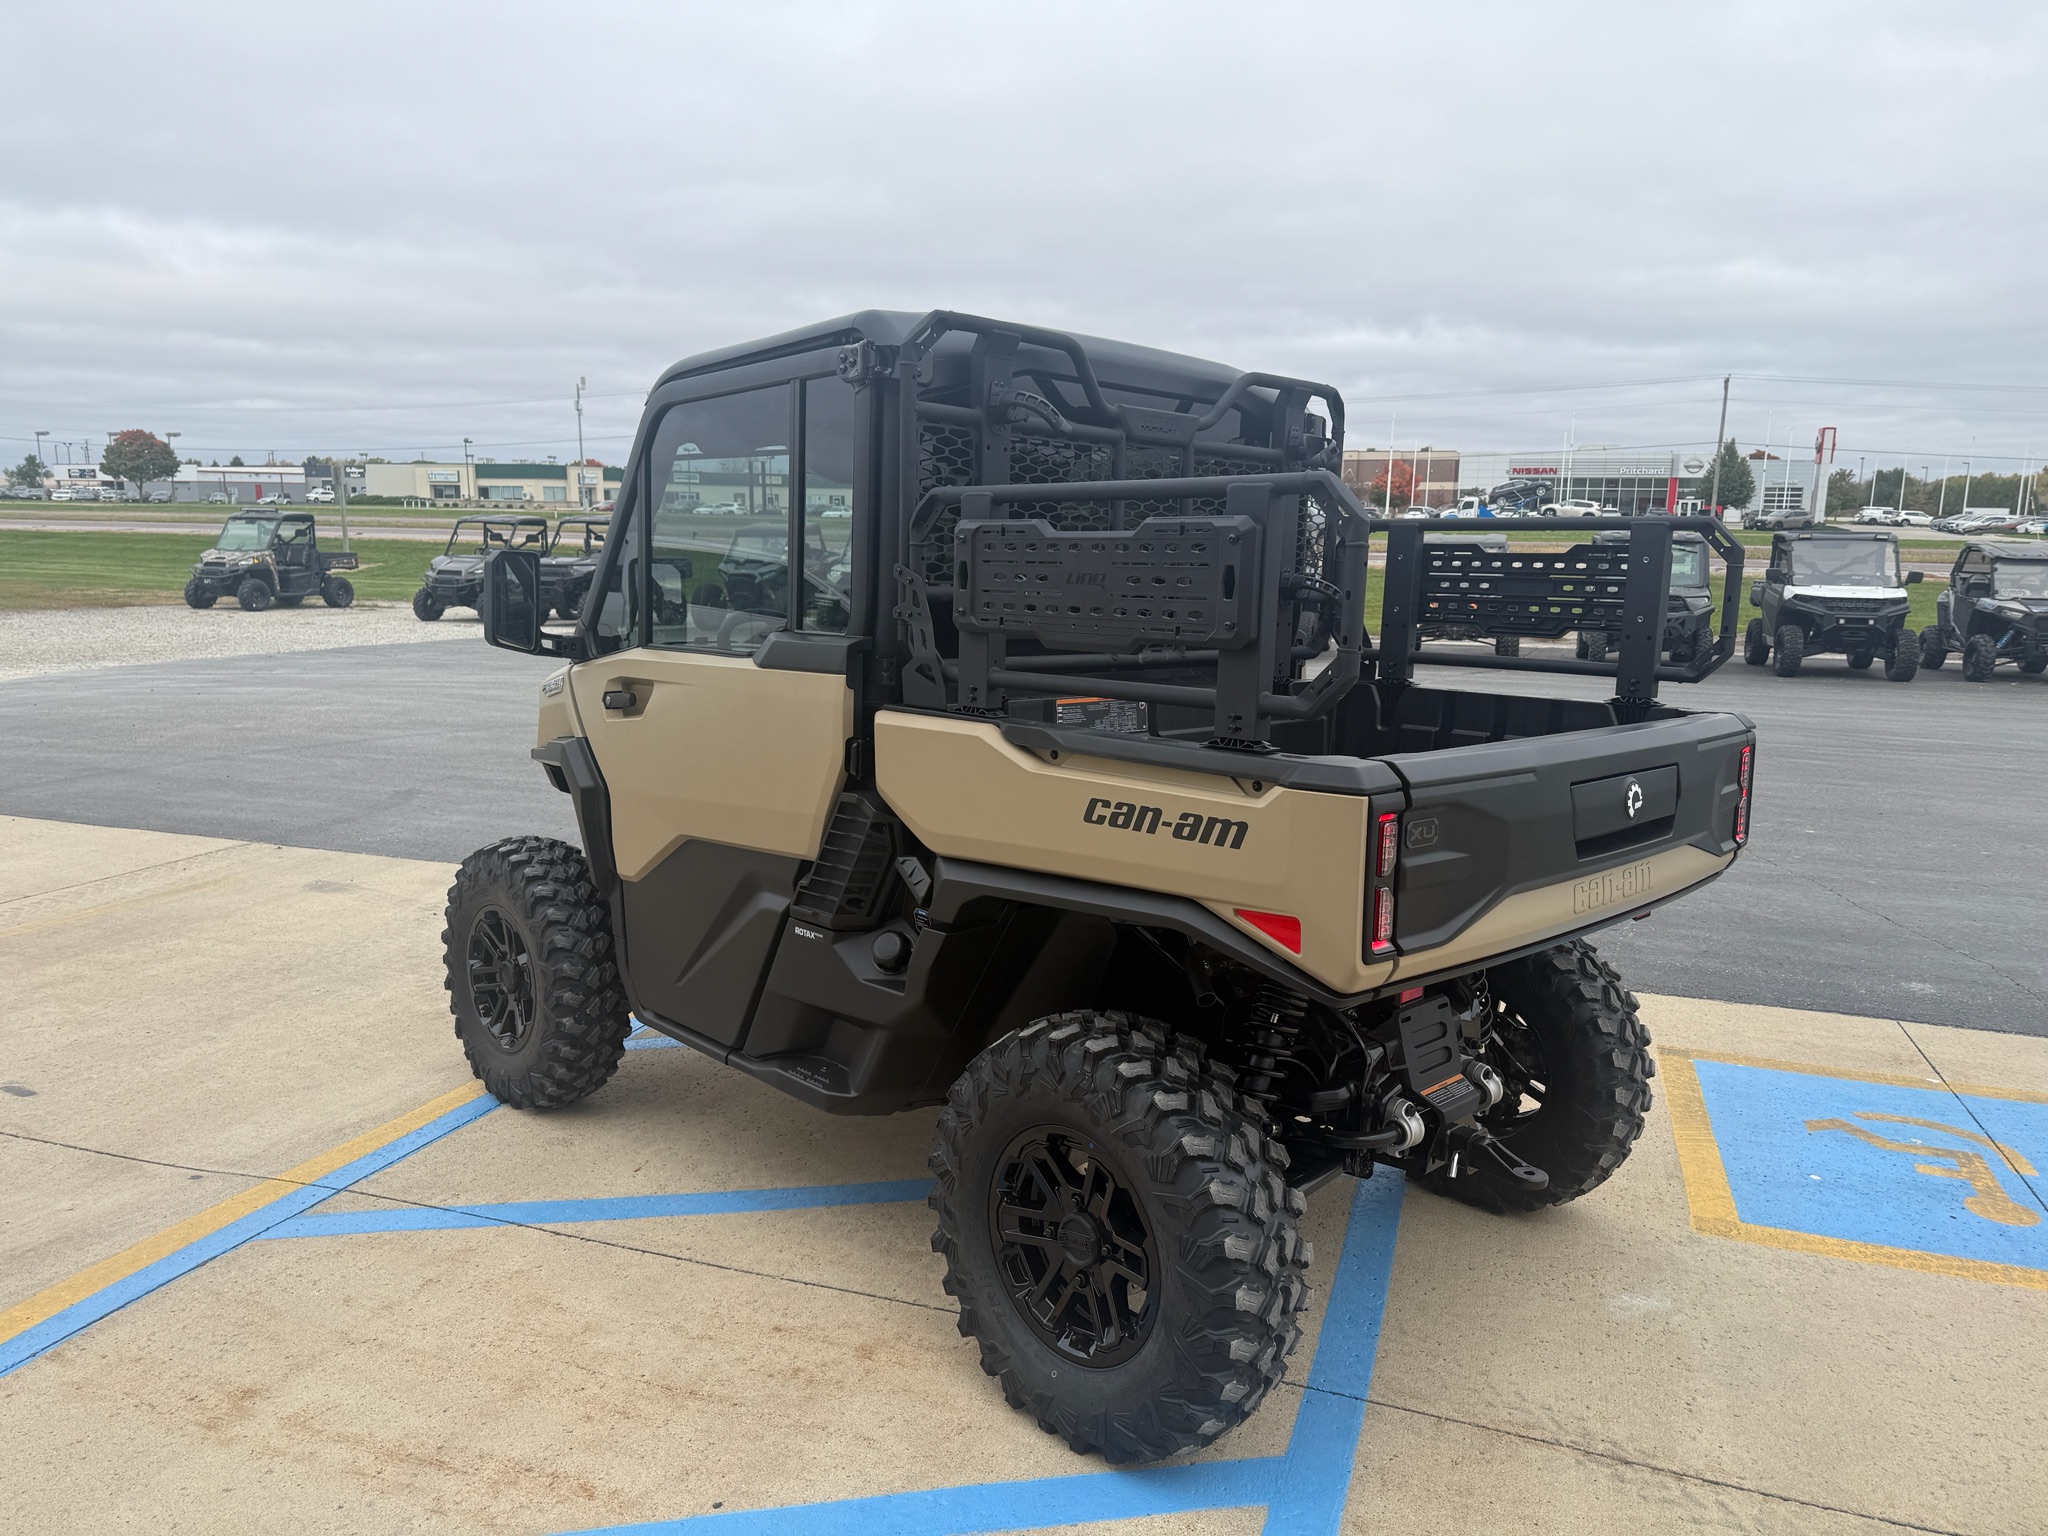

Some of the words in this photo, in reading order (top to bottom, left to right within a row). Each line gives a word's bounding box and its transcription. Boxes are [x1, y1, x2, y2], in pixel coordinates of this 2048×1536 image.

[1512, 467, 1558, 475] NISSAN
[1620, 466, 1664, 475] Pritchard
[1083, 797, 1249, 850] can-am
[1410, 824, 1436, 842] XU
[794, 926, 816, 940] ROTAX
